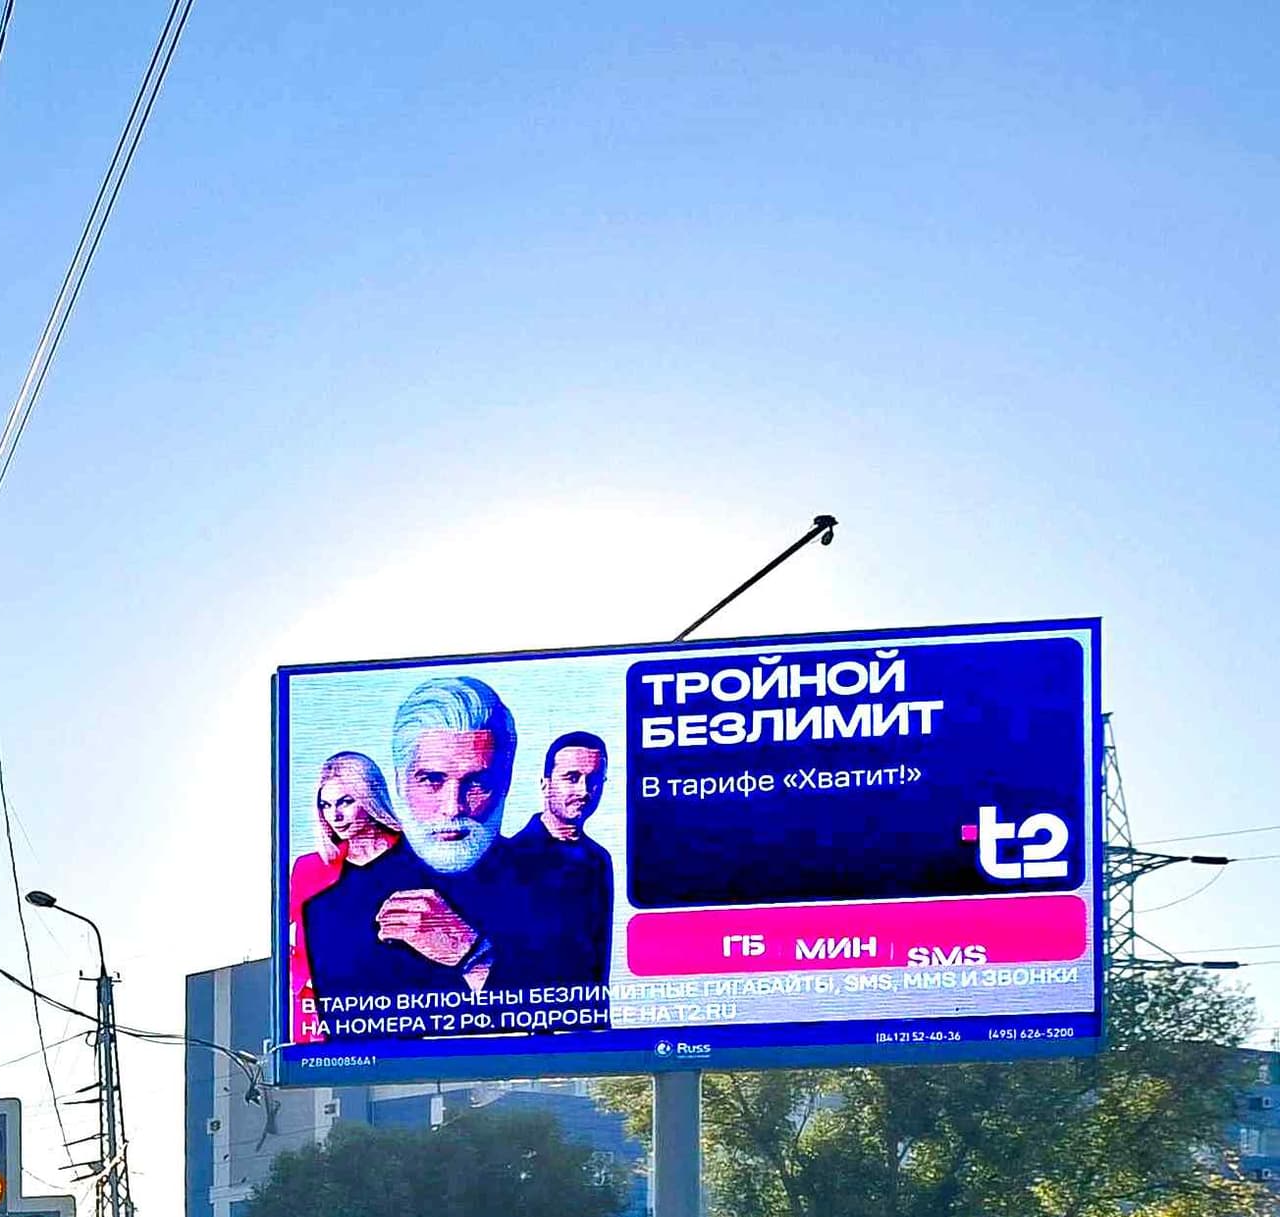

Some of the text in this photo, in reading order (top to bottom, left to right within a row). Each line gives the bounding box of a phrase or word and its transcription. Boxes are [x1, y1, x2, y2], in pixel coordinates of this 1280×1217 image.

[641, 649, 906, 706] ТРОЙНОЙ
[641, 700, 944, 749] БЕЗЛИМИТ
[642, 764, 922, 800] В тарифе «Хватит!»
[979, 806, 1069, 879] t2
[722, 934, 878, 961] ГБ МИН
[907, 945, 988, 967] SMS
[302, 967, 1079, 1014] В ТАРИФ ВКЛЮЧЕНЫ БЕЗЛИМИТНЫЕ ГИГАБАЙТЫ, SMS, MMS И ЗВОНКИ
[302, 1018, 330, 1036] НА
[335, 1014, 426, 1034] НОМЕРА
[461, 1011, 495, 1030] РФ.
[501, 1006, 635, 1029] ПОДРОБНЕЕ
[640, 1006, 670, 1022] НА
[988, 1027, 1074, 1040] (495) 626-5200
[676, 1042, 711, 1054] Russ
